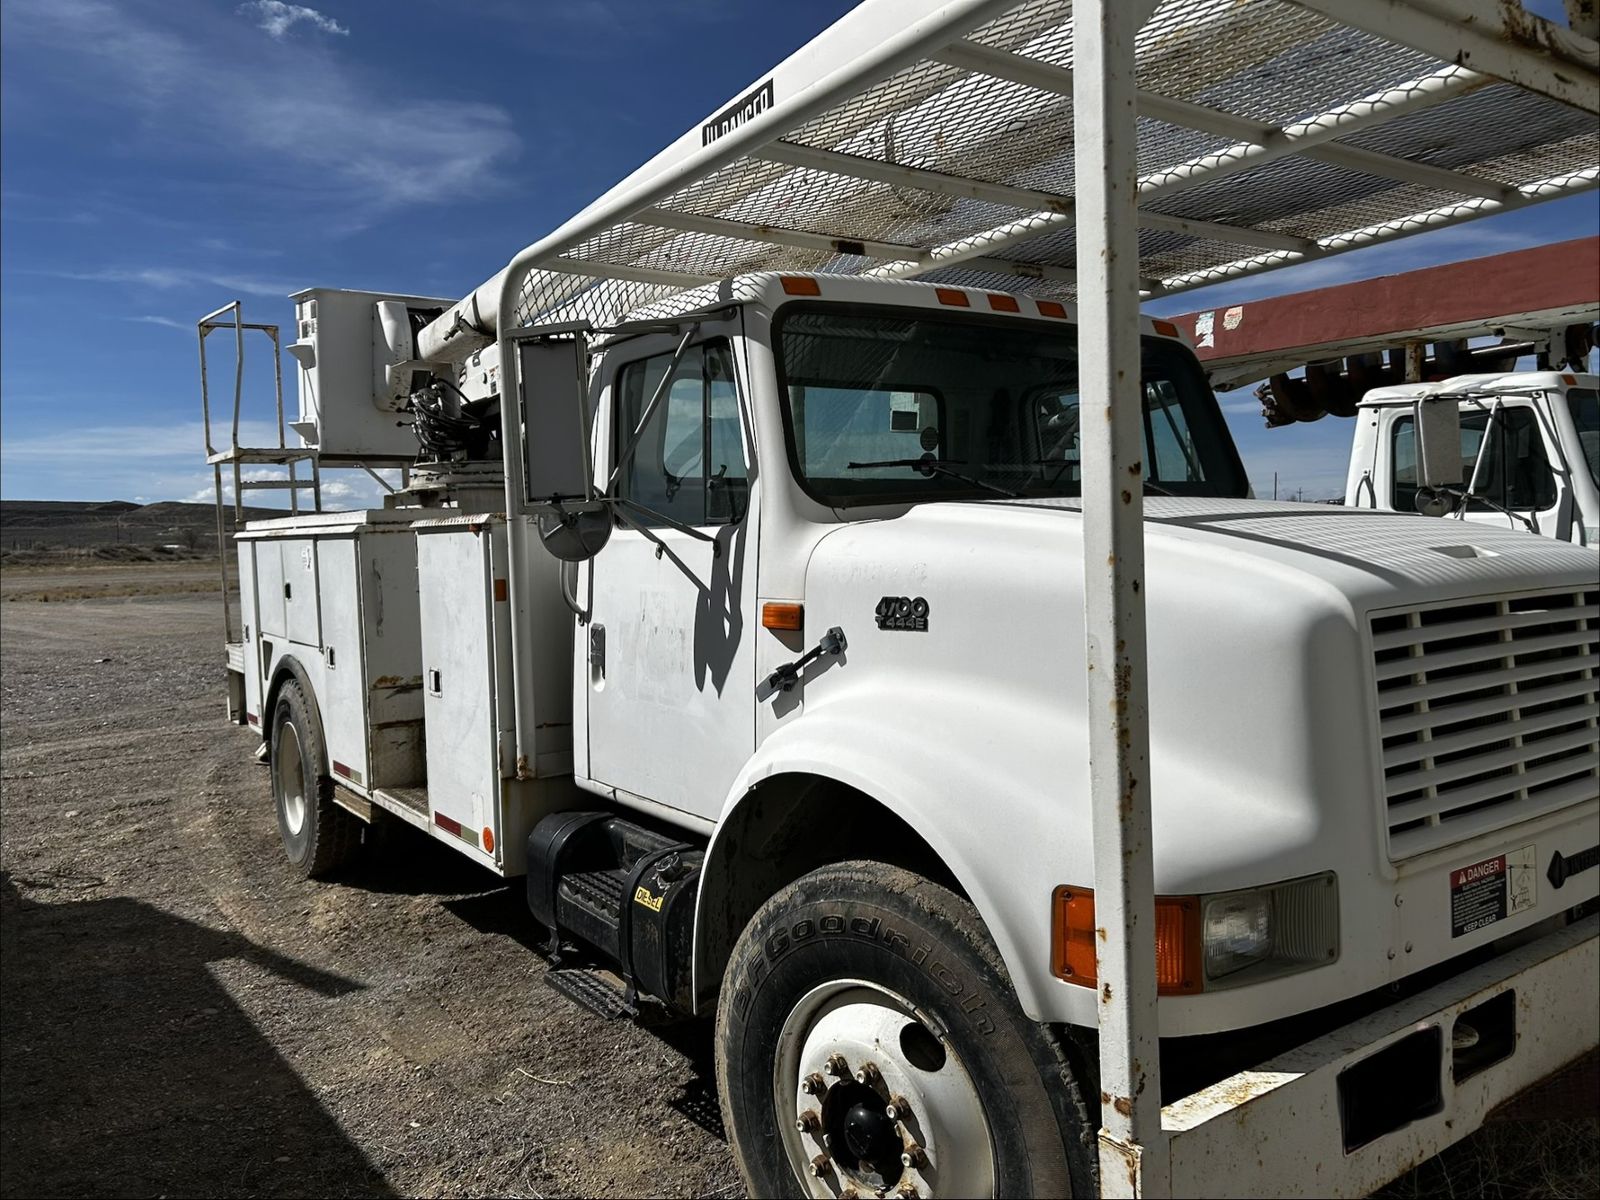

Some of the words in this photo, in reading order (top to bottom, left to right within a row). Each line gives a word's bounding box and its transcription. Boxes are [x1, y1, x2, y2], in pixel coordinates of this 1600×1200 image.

[877, 597, 928, 617] 4700
[886, 617, 926, 630] 444E
[1467, 860, 1500, 880] DANGER
[1463, 921, 1478, 933] KEEP
[1478, 914, 1497, 927] CLEAR
[733, 914, 996, 1037] BFGoodrich
